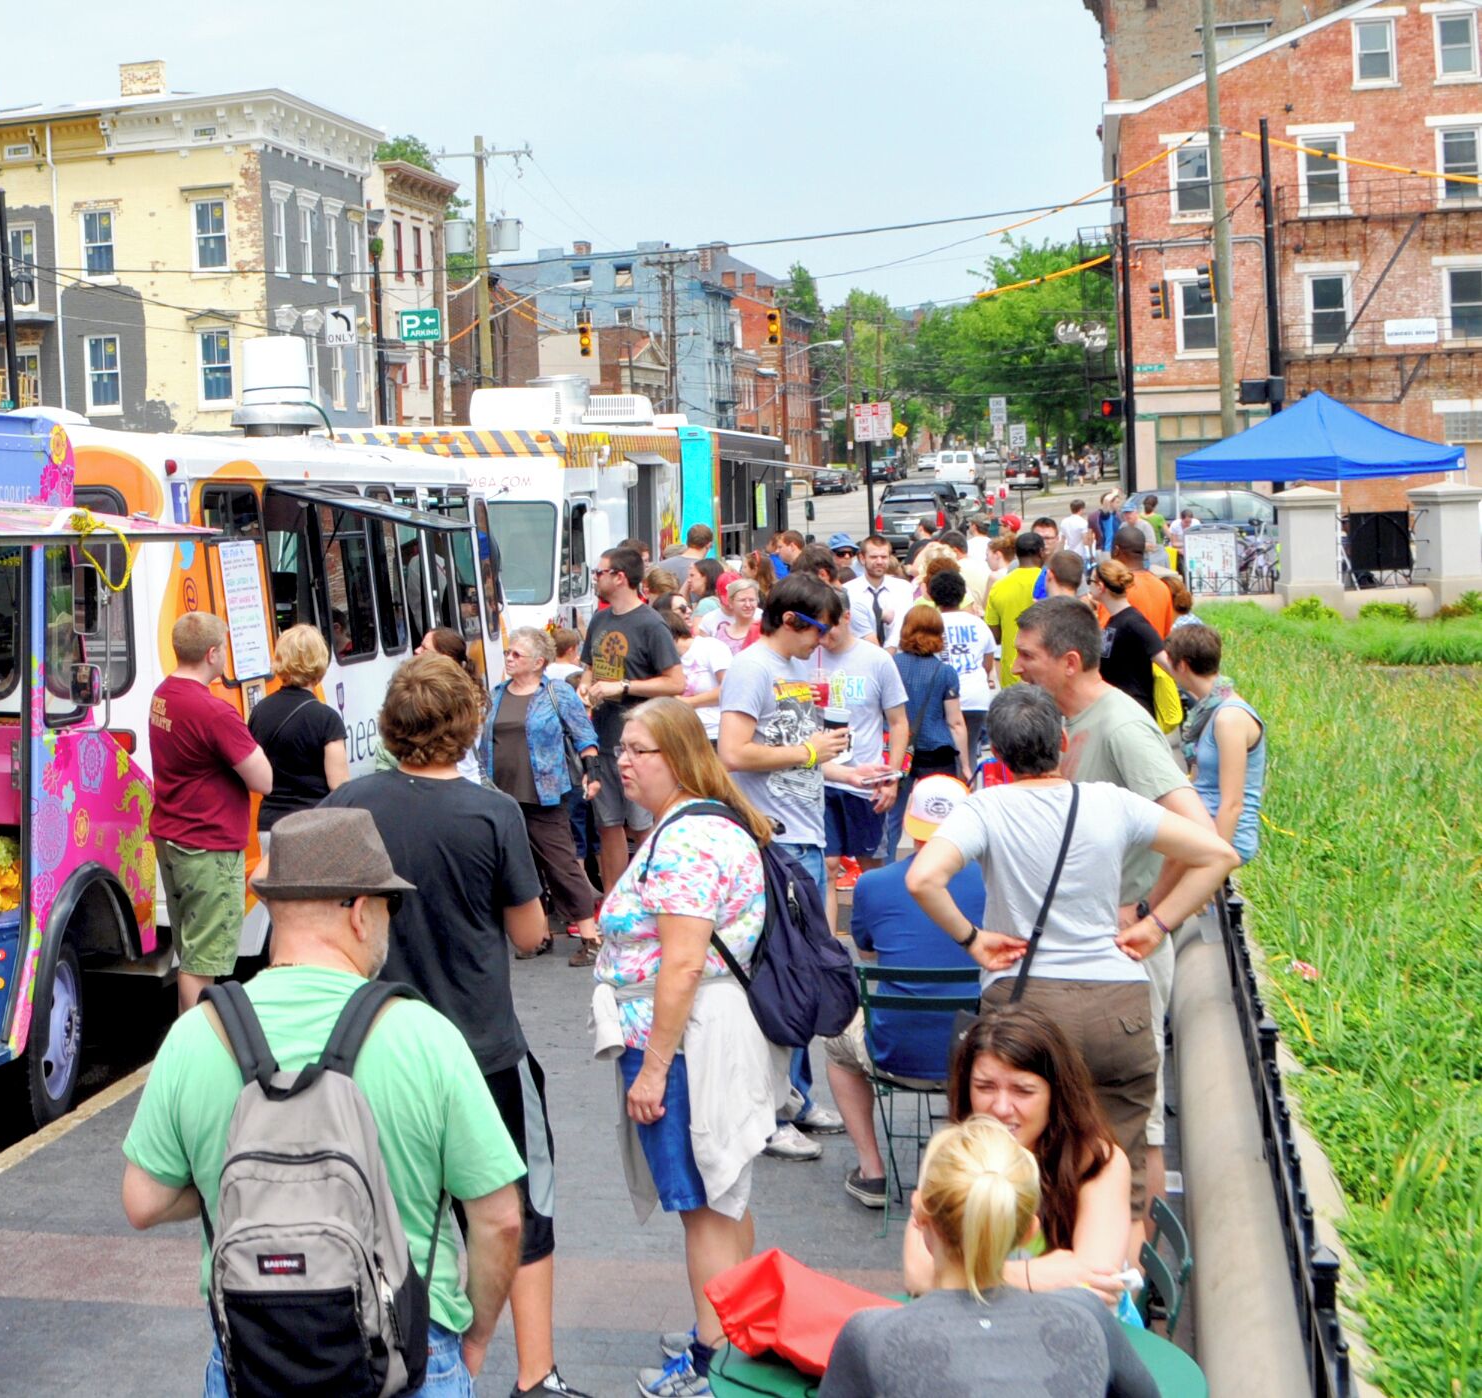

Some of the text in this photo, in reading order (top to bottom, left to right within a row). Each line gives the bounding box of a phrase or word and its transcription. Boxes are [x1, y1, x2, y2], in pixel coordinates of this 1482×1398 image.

[402, 315, 439, 337] PARKING
[328, 333, 355, 343] ONLY
[1012, 435, 1025, 445] 25
[947, 624, 979, 644] FINE
[950, 643, 971, 655] &
[846, 676, 865, 699] 5K
